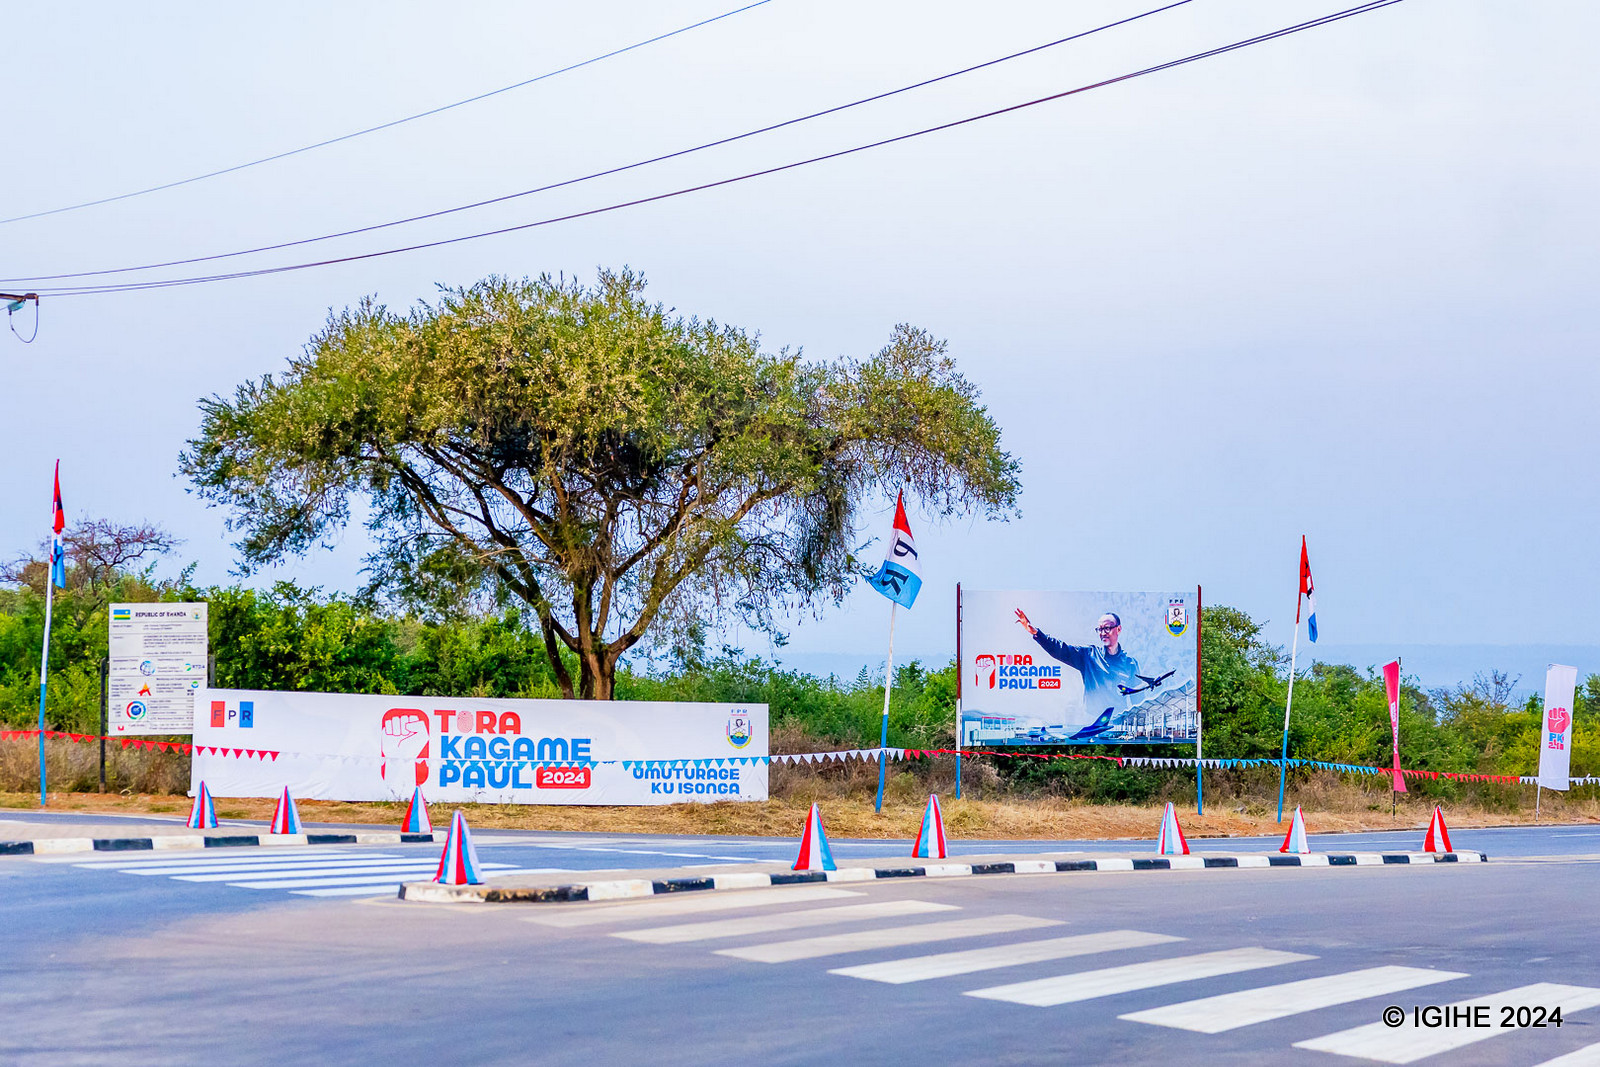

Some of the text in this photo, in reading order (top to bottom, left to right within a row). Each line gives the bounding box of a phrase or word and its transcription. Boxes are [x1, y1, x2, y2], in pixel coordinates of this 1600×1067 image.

[996, 654, 1033, 665] TORA
[999, 665, 1062, 677] KAGAME
[999, 678, 1059, 690] PAUL 2024
[433, 709, 522, 735] TORA
[440, 735, 592, 761] KAGAME
[439, 763, 586, 790] PAUL 2024
[632, 767, 740, 780] UMUTURAGE
[651, 782, 740, 795] KU ISONGA
